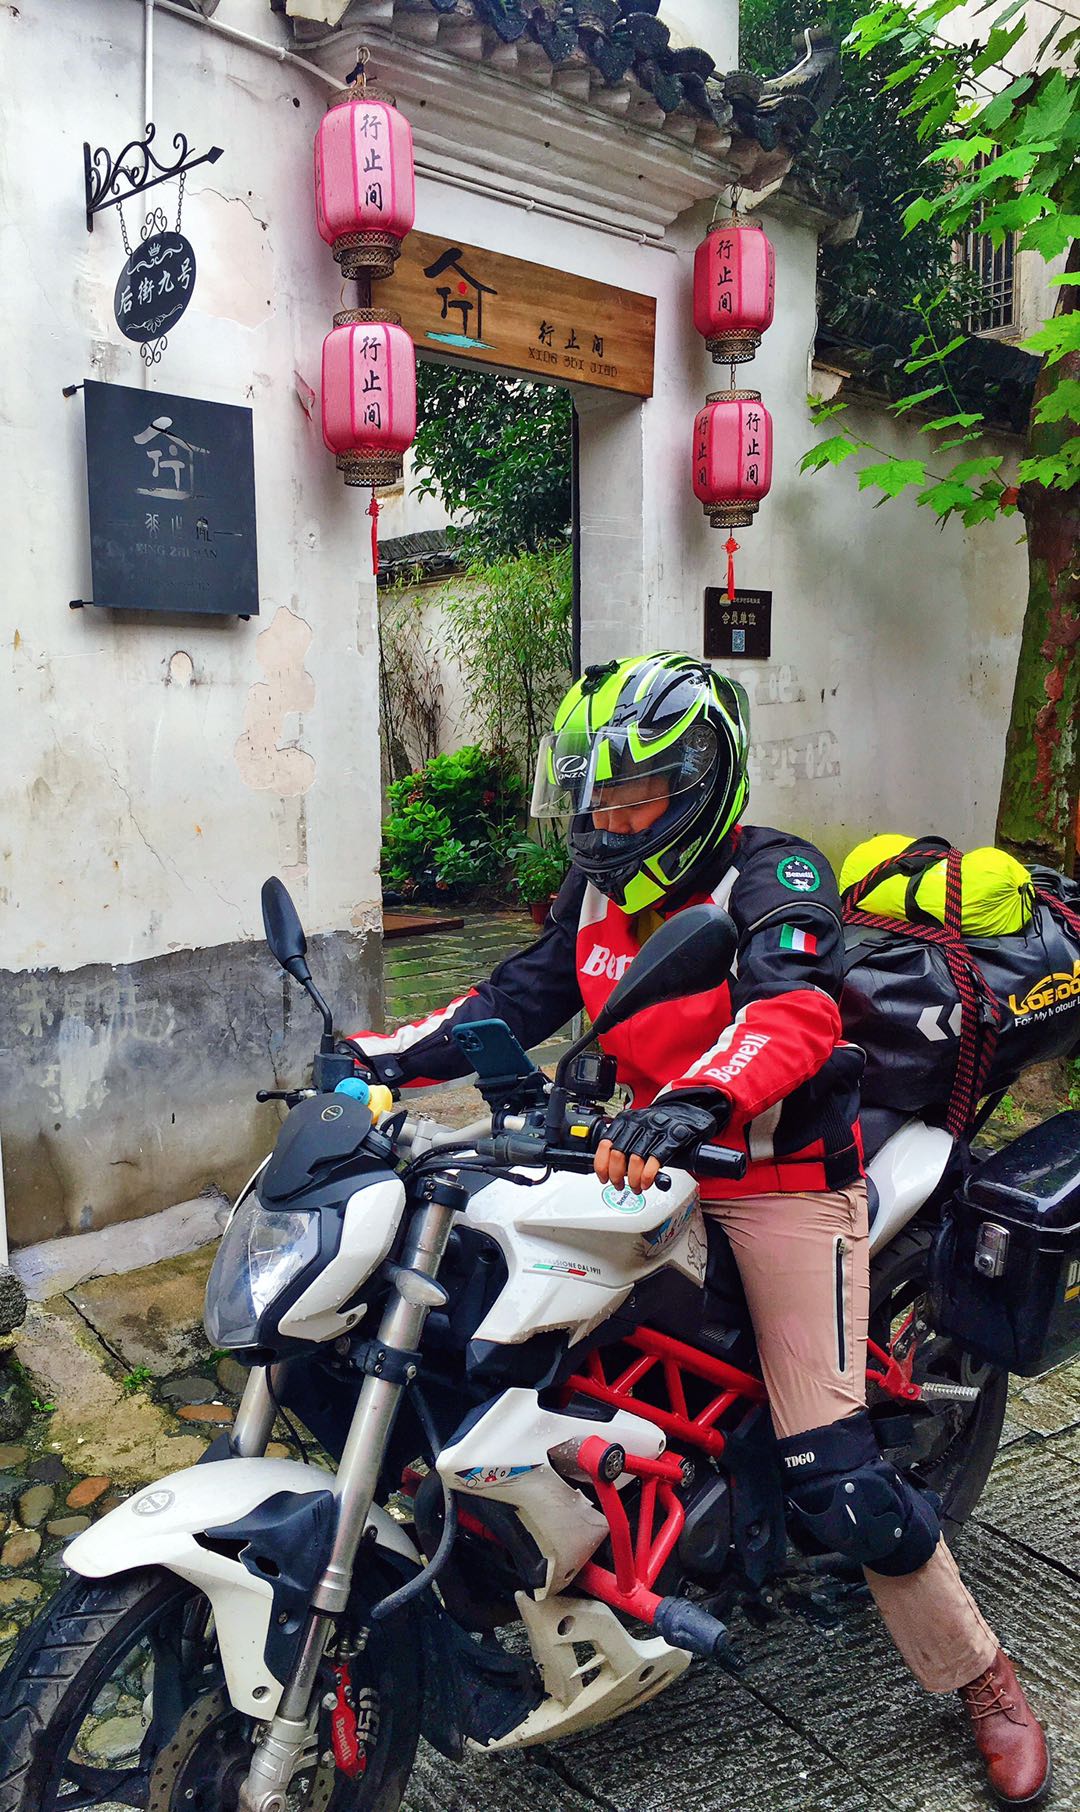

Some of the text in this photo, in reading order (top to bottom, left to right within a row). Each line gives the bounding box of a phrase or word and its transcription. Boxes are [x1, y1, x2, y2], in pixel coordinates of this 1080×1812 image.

[360, 113, 383, 212] 行止间
[117, 257, 193, 317] 后街九号
[715, 239, 734, 315] 行止间
[538, 319, 604, 358] 行止间
[360, 335, 383, 430] 行止间
[697, 415, 708, 487] 行止间
[745, 411, 761, 486] 行止间
[721, 610, 756, 626] 会员单位
[1014, 1017, 1033, 1028] For
[1034, 1011, 1047, 1021] My
[703, 1031, 771, 1084] Benelli
[784, 1451, 815, 1468] TDGO
[336, 1718, 352, 1761] Benelli
